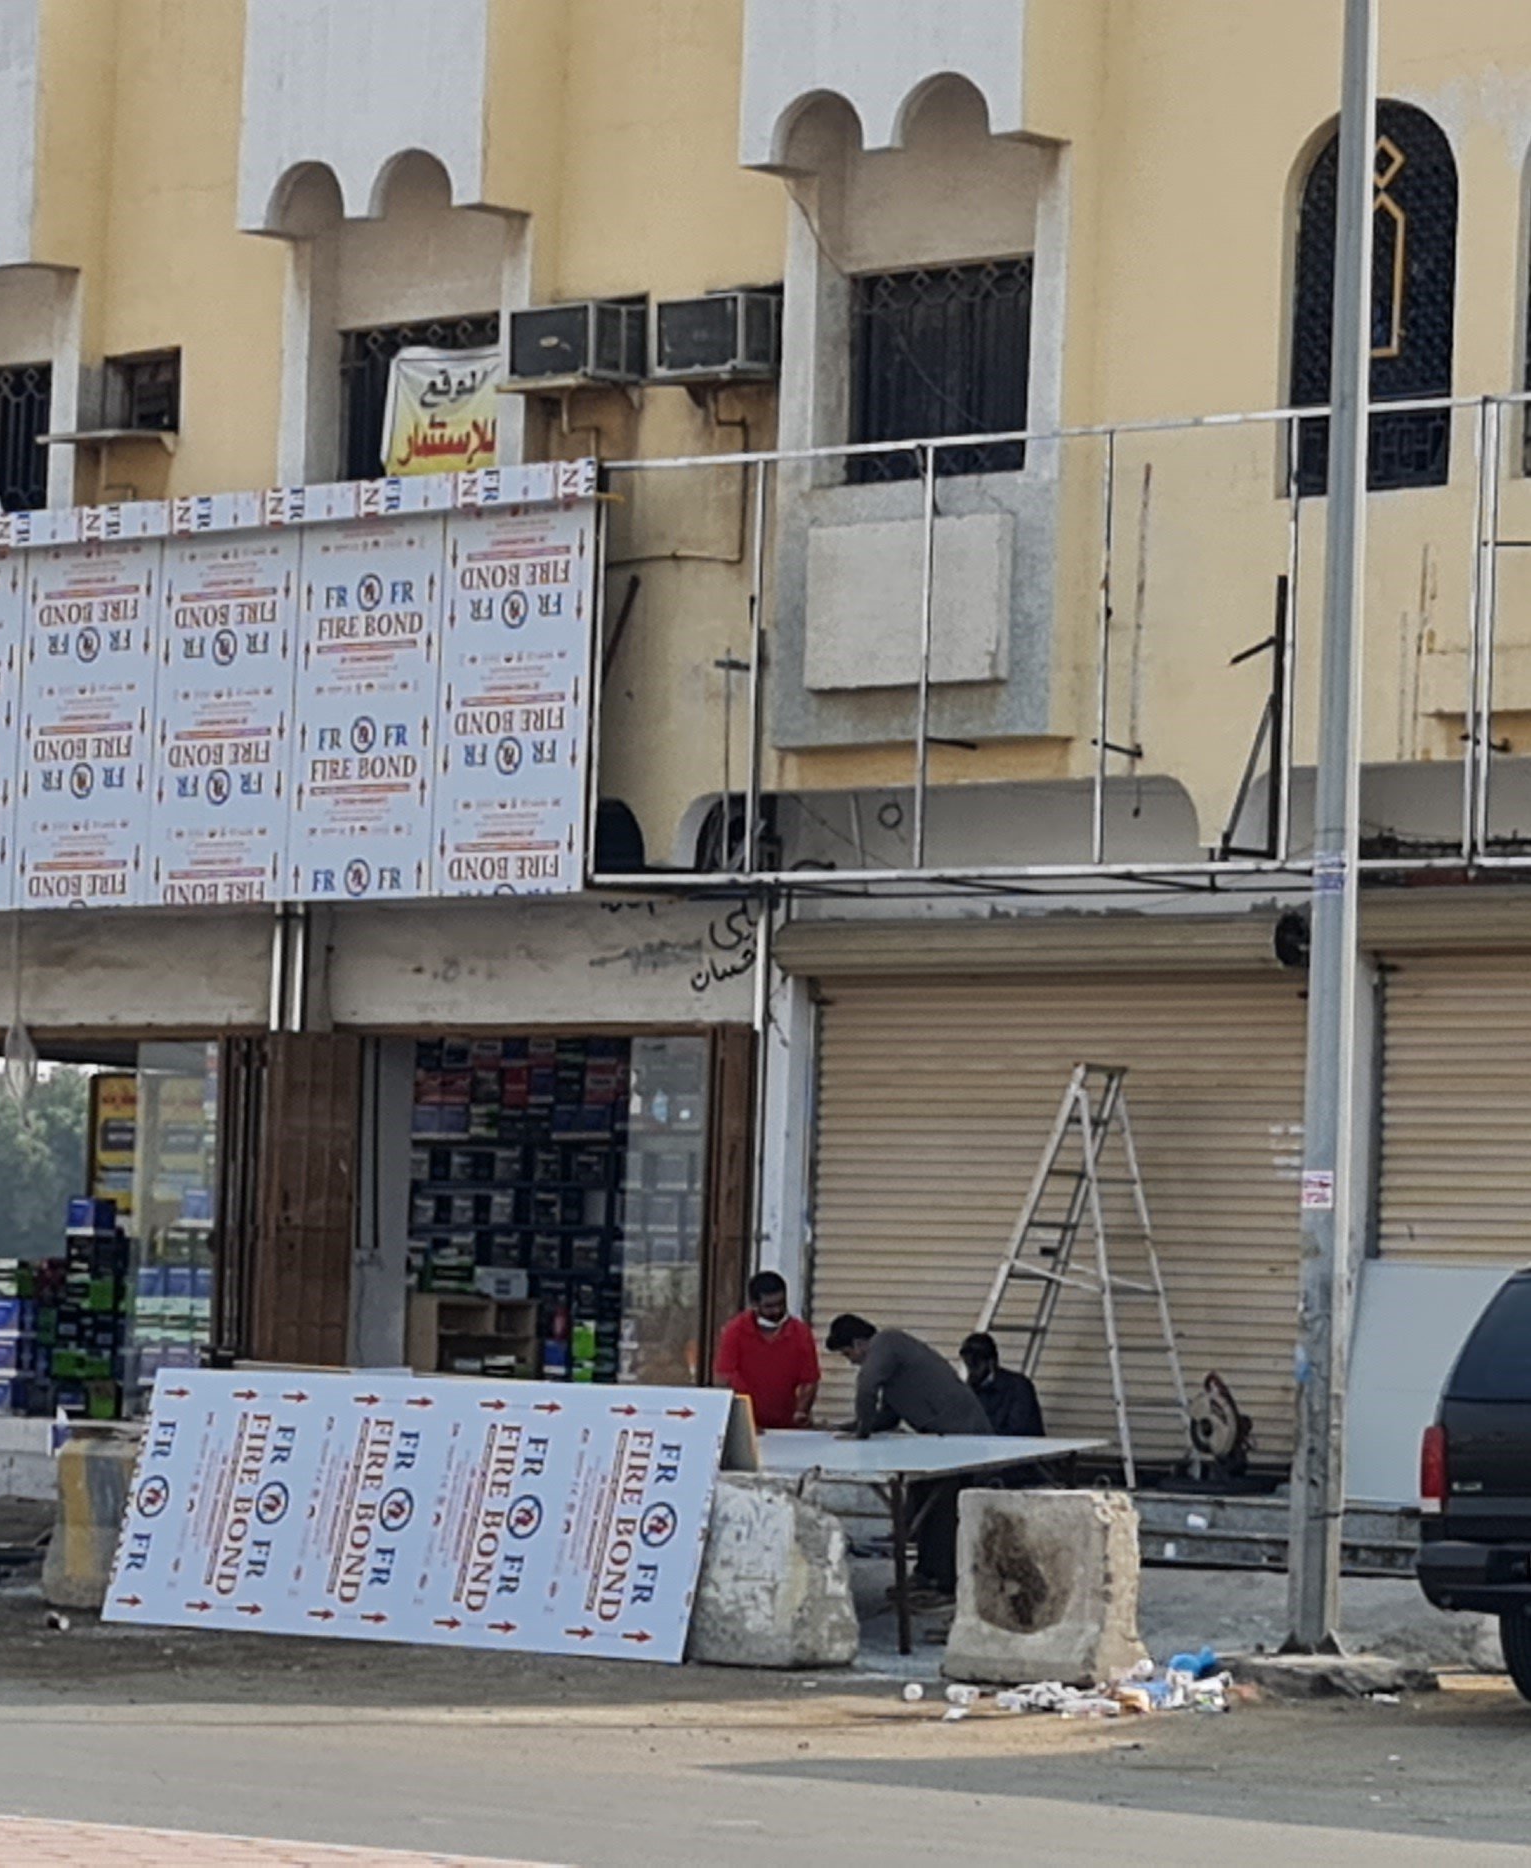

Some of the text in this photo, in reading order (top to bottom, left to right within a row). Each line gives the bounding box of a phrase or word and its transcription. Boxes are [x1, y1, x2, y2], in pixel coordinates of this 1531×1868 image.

[461, 559, 570, 589] FIRE BOND
[325, 581, 414, 607] FR FR
[470, 593, 562, 621] FR FR
[39, 601, 138, 625] FIRE BOND
[175, 601, 276, 627] FIRE BOND
[318, 611, 423, 639] FIRE BOND
[48, 629, 131, 655] FR FR
[183, 631, 269, 658] FR FR
[456, 707, 564, 735] FIRE BOND
[34, 736, 132, 761] FIRE BOND
[318, 724, 408, 750] FR FR
[168, 741, 270, 767] FIRE BOND
[464, 739, 556, 766] FR FR
[42, 766, 125, 791] FR FR
[311, 754, 416, 781] FIRE BOND
[177, 772, 263, 796] FR FR
[312, 866, 401, 892] FR FR
[449, 854, 559, 880] FIRE BOND
[29, 874, 126, 896] FIRE BOND
[124, 1420, 177, 1572] FR FR
[216, 1413, 271, 1595] FIRE BOND
[245, 1426, 296, 1578] FR FR
[369, 1431, 420, 1586] FR FR
[338, 1420, 394, 1603] FIRE BOND
[465, 1425, 522, 1611] FIRE BOND
[496, 1437, 549, 1595] FR FR
[631, 1443, 682, 1606] FR FR
[598, 1430, 654, 1622] FIRE BOND
